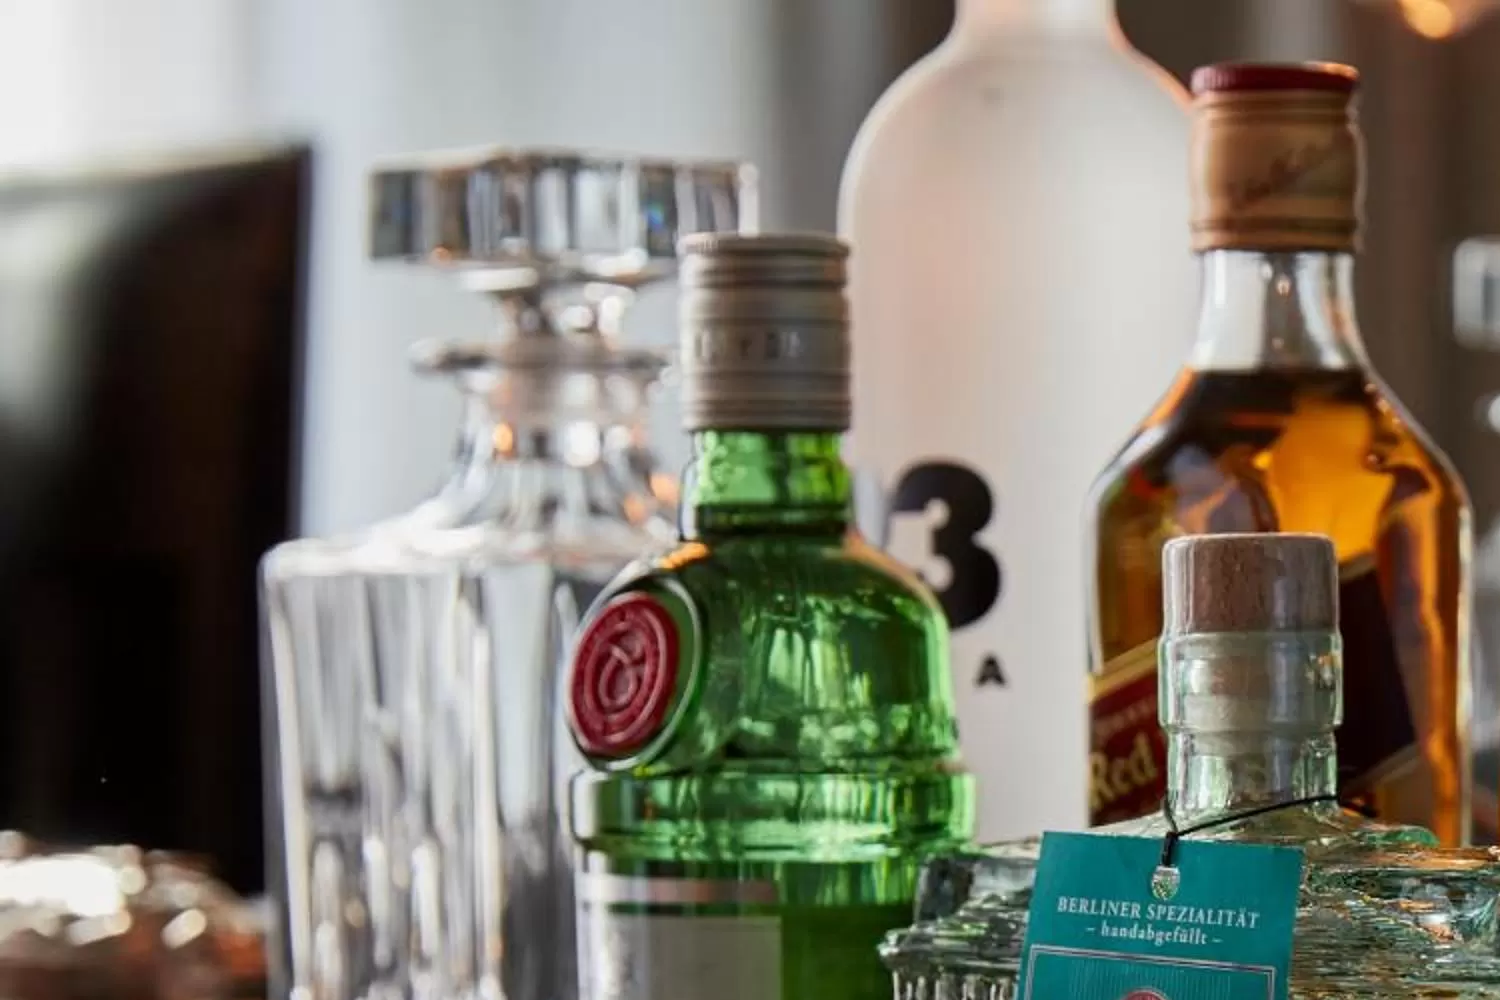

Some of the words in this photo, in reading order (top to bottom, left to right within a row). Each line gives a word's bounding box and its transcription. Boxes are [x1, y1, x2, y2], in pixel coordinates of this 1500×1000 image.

[1089, 732, 1157, 810] Red
[1057, 896, 1142, 919] BERLINER
[1146, 903, 1260, 929] SPEZIALITÄT
[1101, 920, 1207, 946] handabgefüllt
